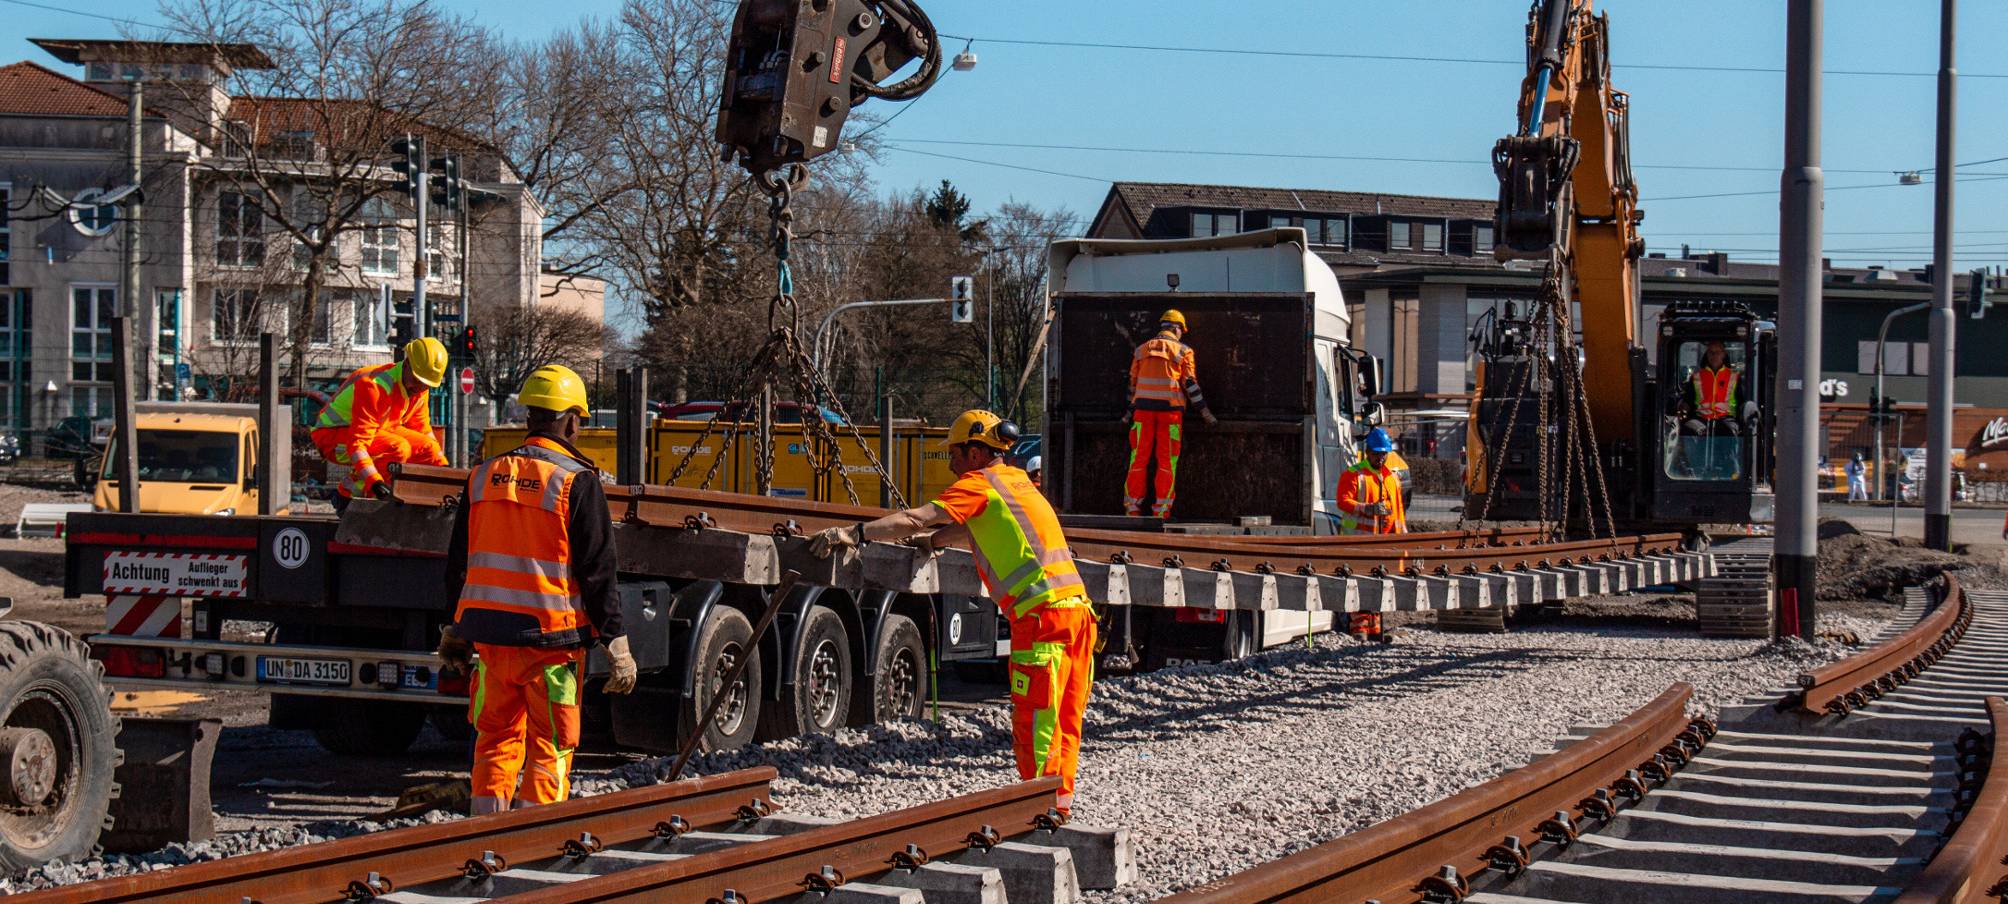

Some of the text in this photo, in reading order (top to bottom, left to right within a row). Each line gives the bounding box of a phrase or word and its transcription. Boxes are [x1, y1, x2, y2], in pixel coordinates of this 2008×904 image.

[281, 535, 302, 561] 80
[112, 562, 170, 584] Achtung
[188, 562, 228, 575] Auflieger
[178, 576, 239, 588] schwenkt aus
[953, 619, 960, 638] 80
[266, 660, 348, 680] UN DA 3150
